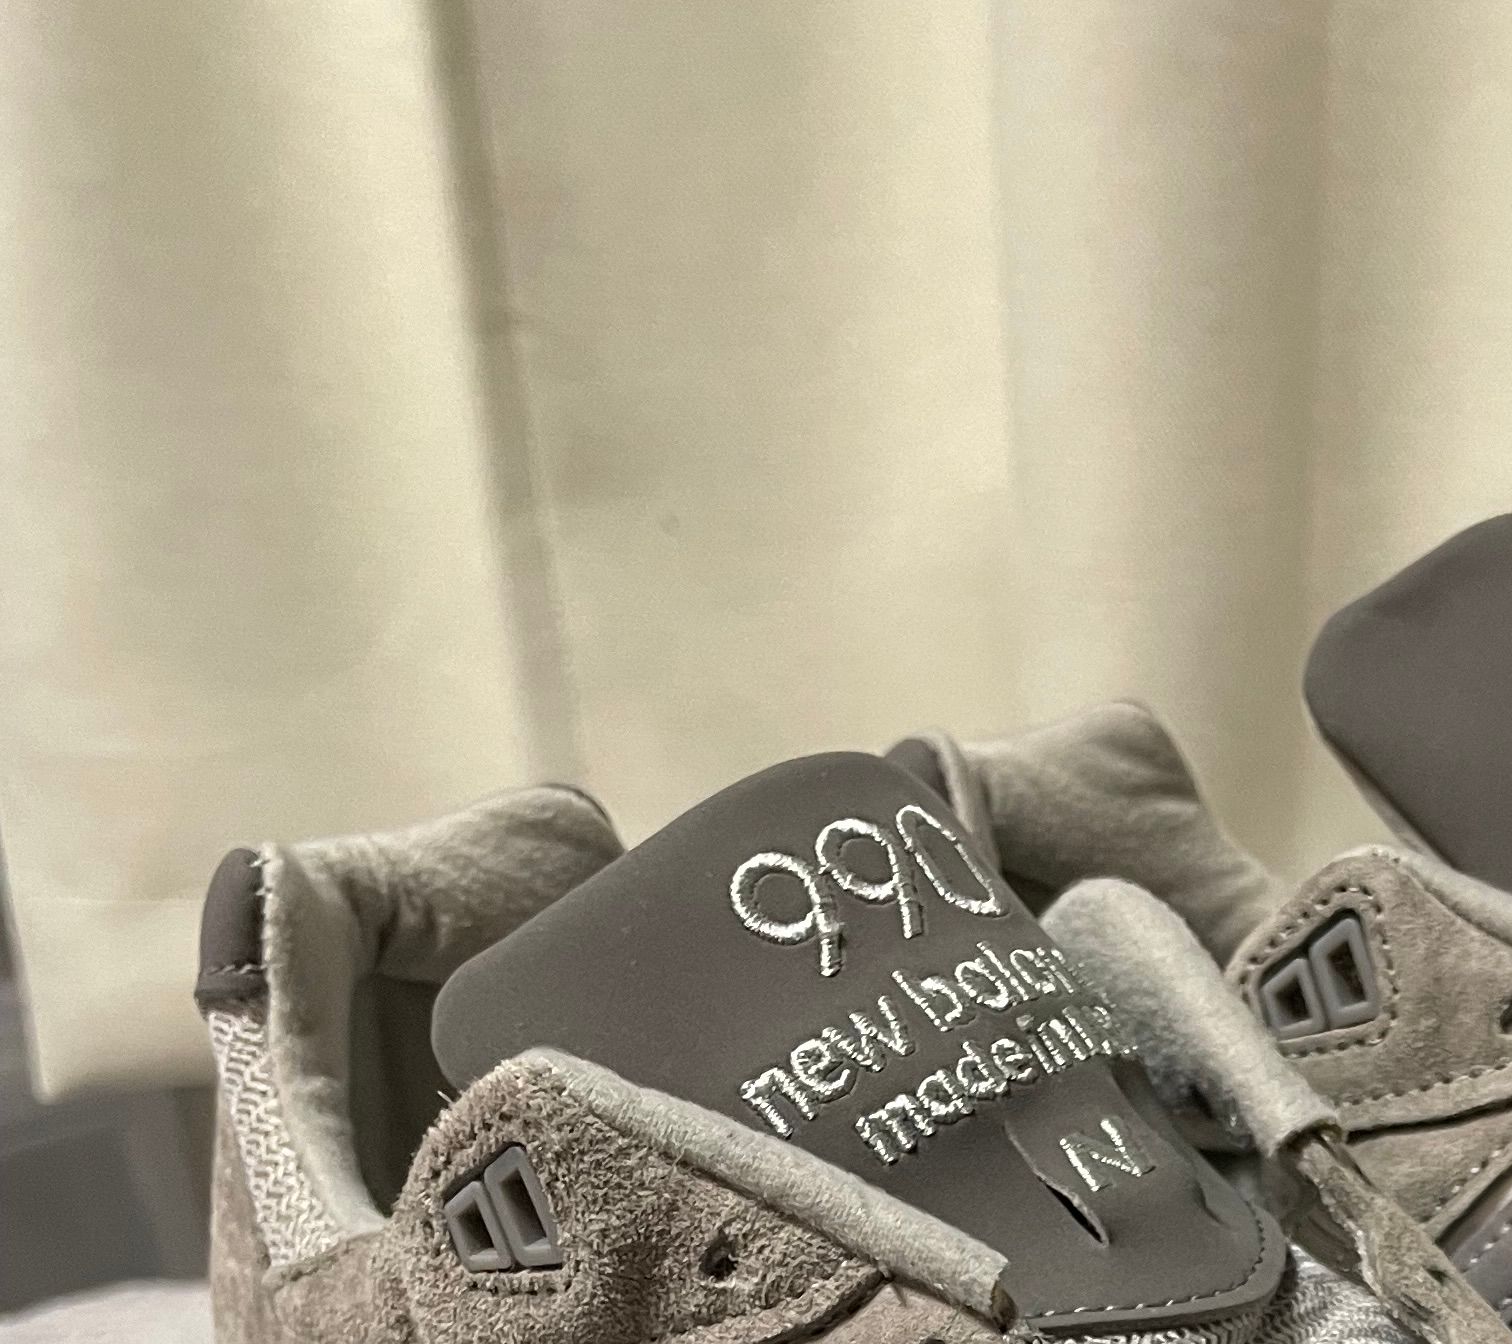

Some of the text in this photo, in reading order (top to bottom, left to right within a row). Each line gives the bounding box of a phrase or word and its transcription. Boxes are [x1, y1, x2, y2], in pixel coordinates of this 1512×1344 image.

[730, 804, 1004, 977] 990
[740, 994, 915, 1140] new
[853, 1039, 1036, 1166] made
[1058, 1117, 1157, 1193] N
